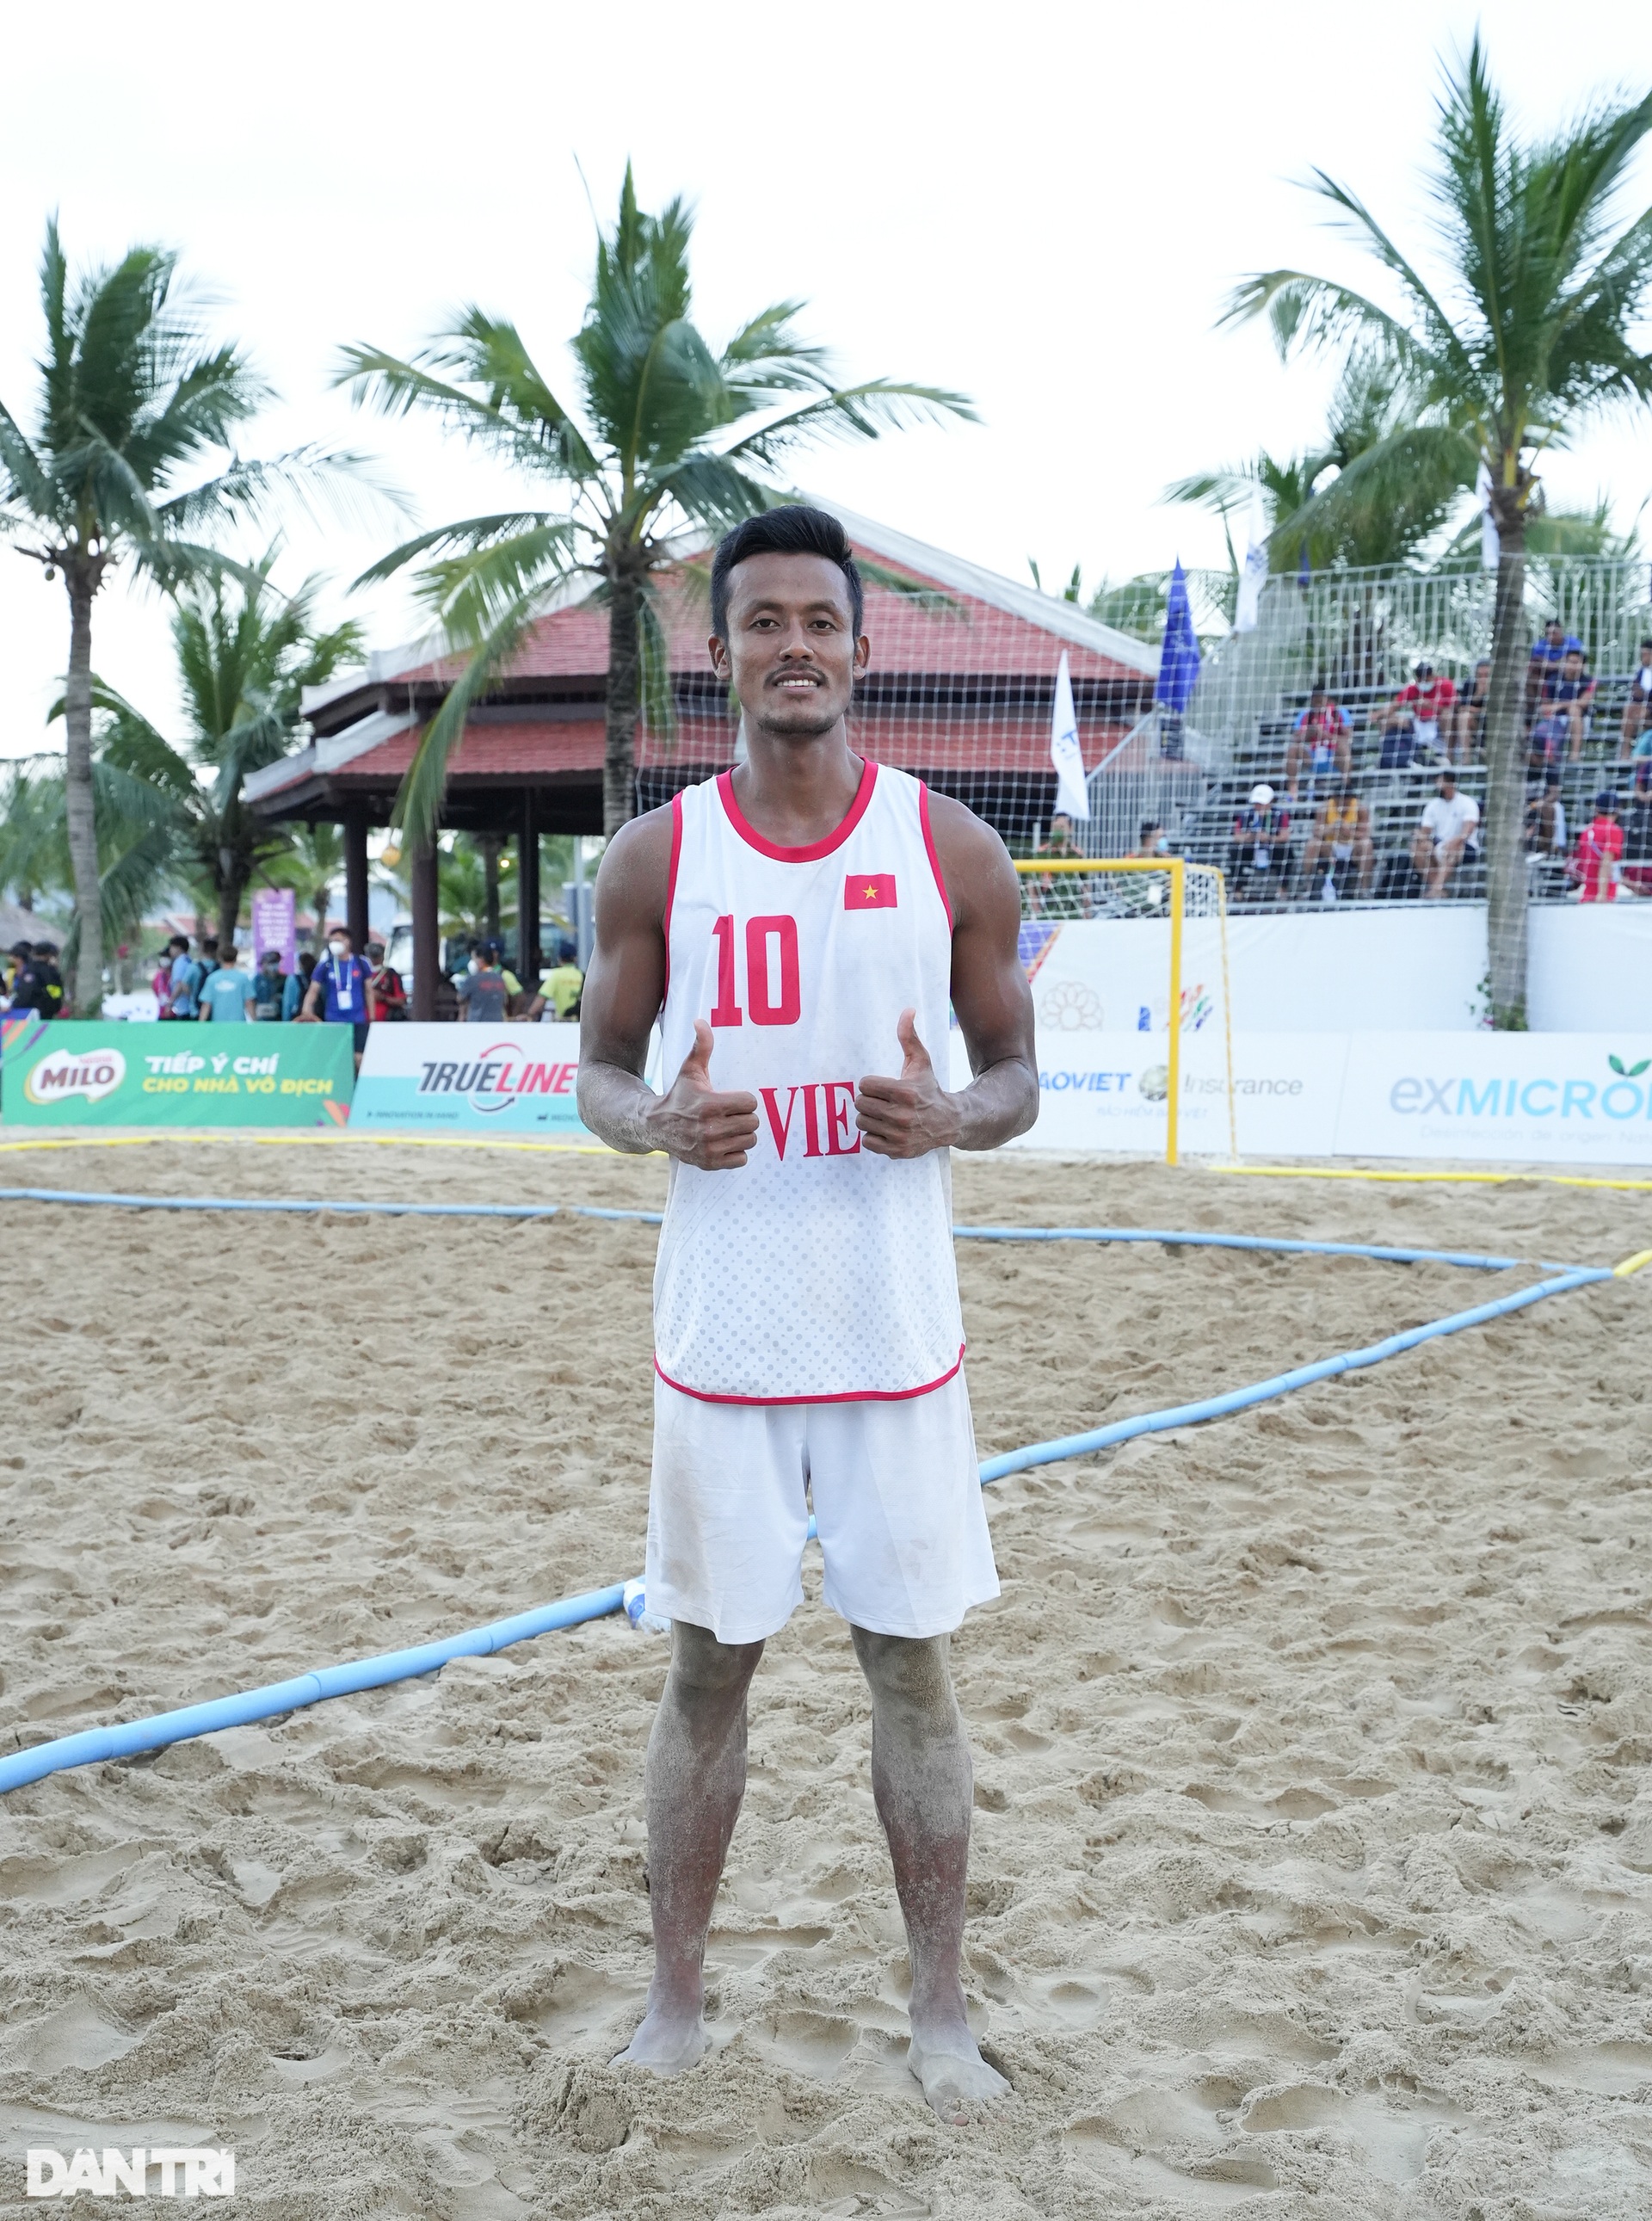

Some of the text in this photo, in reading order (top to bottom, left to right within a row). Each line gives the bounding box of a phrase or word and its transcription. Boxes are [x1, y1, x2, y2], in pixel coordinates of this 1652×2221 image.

[711, 914, 801, 1027] 10
[145, 1050, 280, 1076] TIẾP Ý CHÍ
[40, 1066, 114, 1089] MILO
[143, 1074, 333, 1097] CHO NHÀ VÔ ĐỊCH
[420, 1062, 578, 1093] TRUELINE
[1039, 1071, 1132, 1091] AOVIET
[1390, 1077, 1652, 1121] exMICRO
[759, 1081, 860, 1161] VIE
